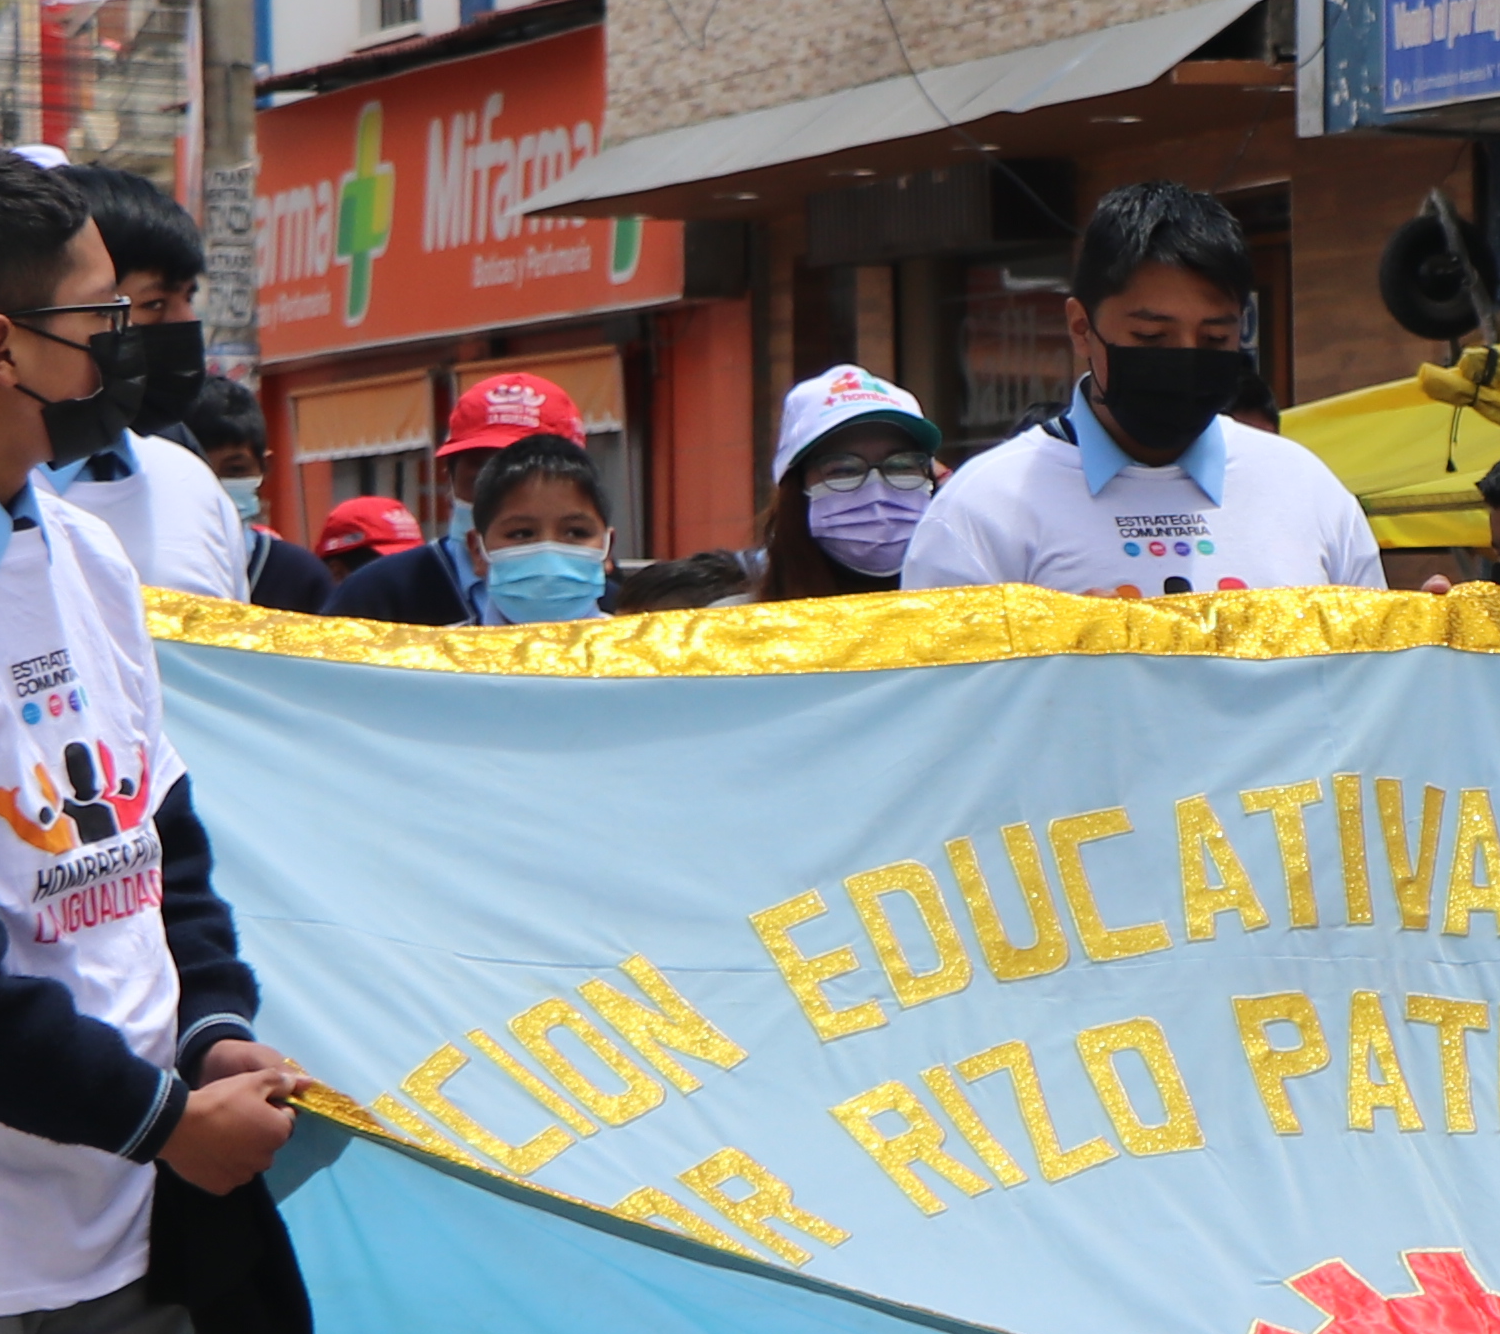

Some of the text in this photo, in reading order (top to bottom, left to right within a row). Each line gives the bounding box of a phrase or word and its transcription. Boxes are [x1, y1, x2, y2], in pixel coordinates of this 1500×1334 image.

[256, 176, 335, 290] arma
[1114, 513, 1210, 528] ESTRATEGIA
[1118, 525, 1212, 539] COMUNITARIA
[828, 1014, 1207, 1218] RIZO
